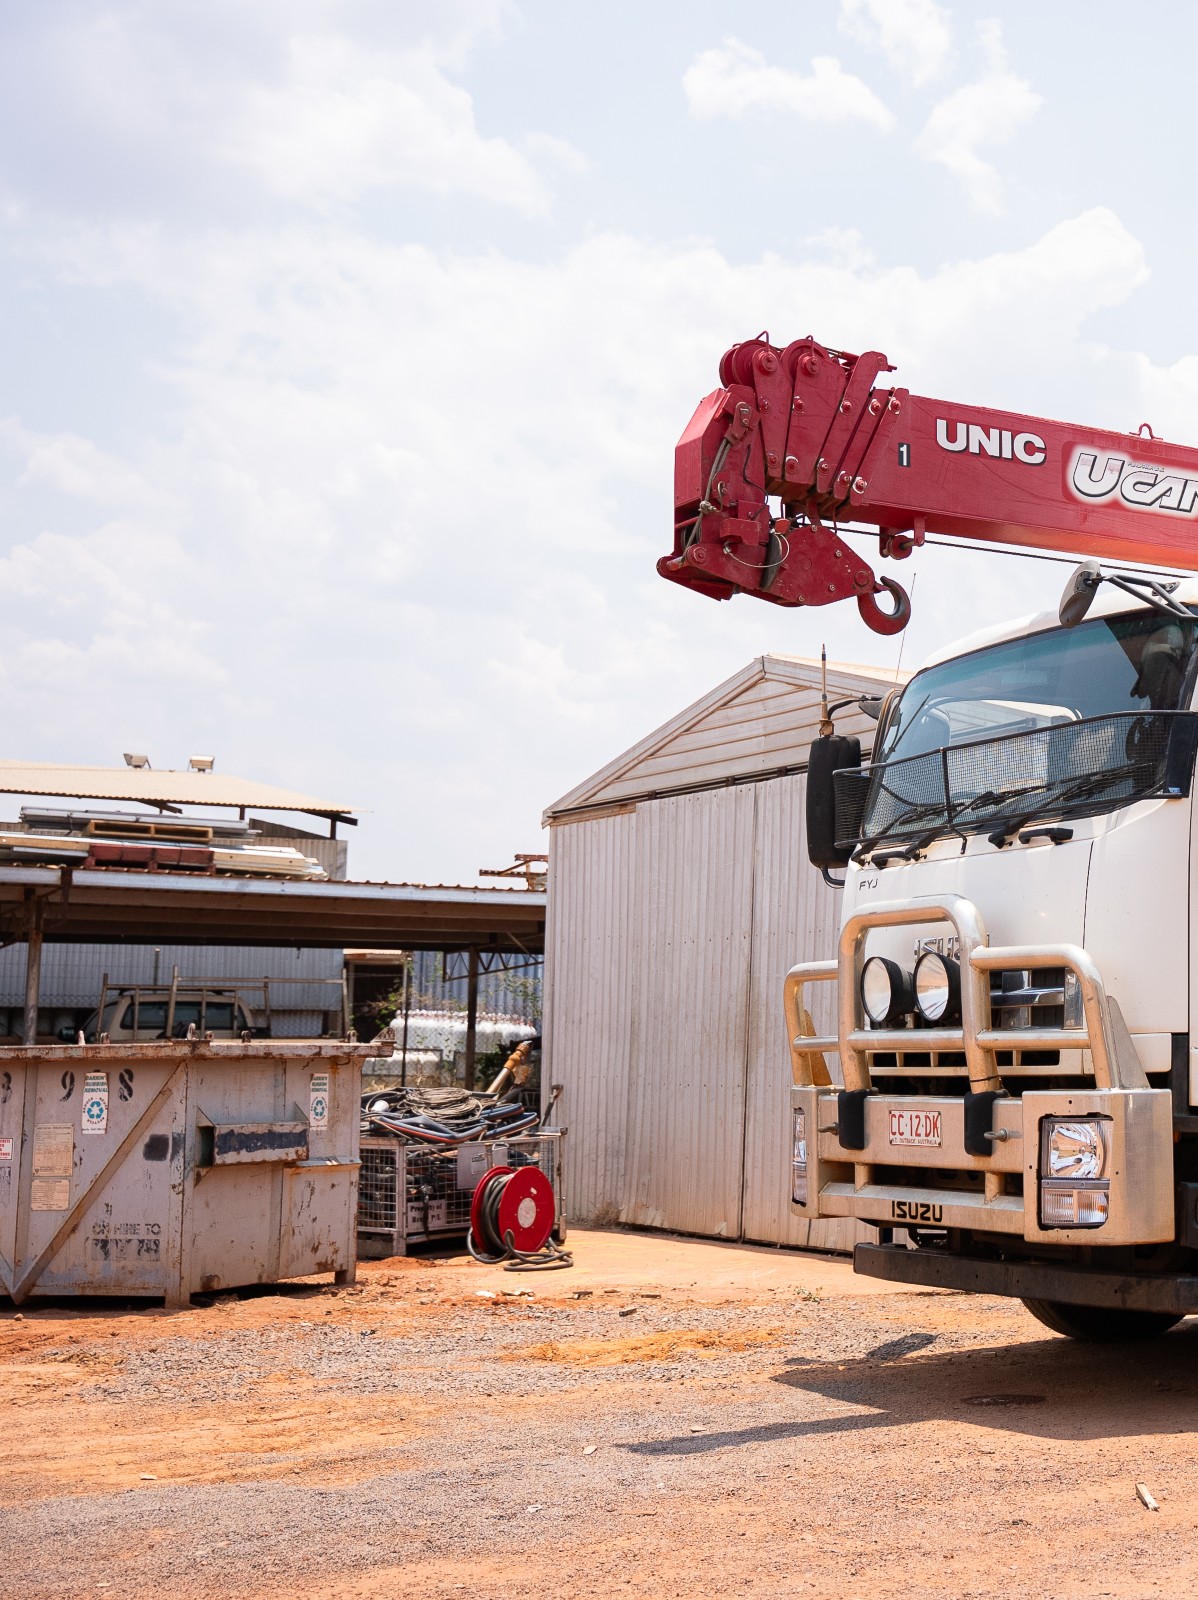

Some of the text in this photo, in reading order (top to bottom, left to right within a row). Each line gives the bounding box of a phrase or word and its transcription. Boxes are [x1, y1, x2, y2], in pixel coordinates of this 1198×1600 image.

[936, 418, 1047, 466] UNIC
[899, 444, 908, 466] 1
[858, 878, 879, 891] FYJ
[891, 1200, 943, 1222] ISUZU
